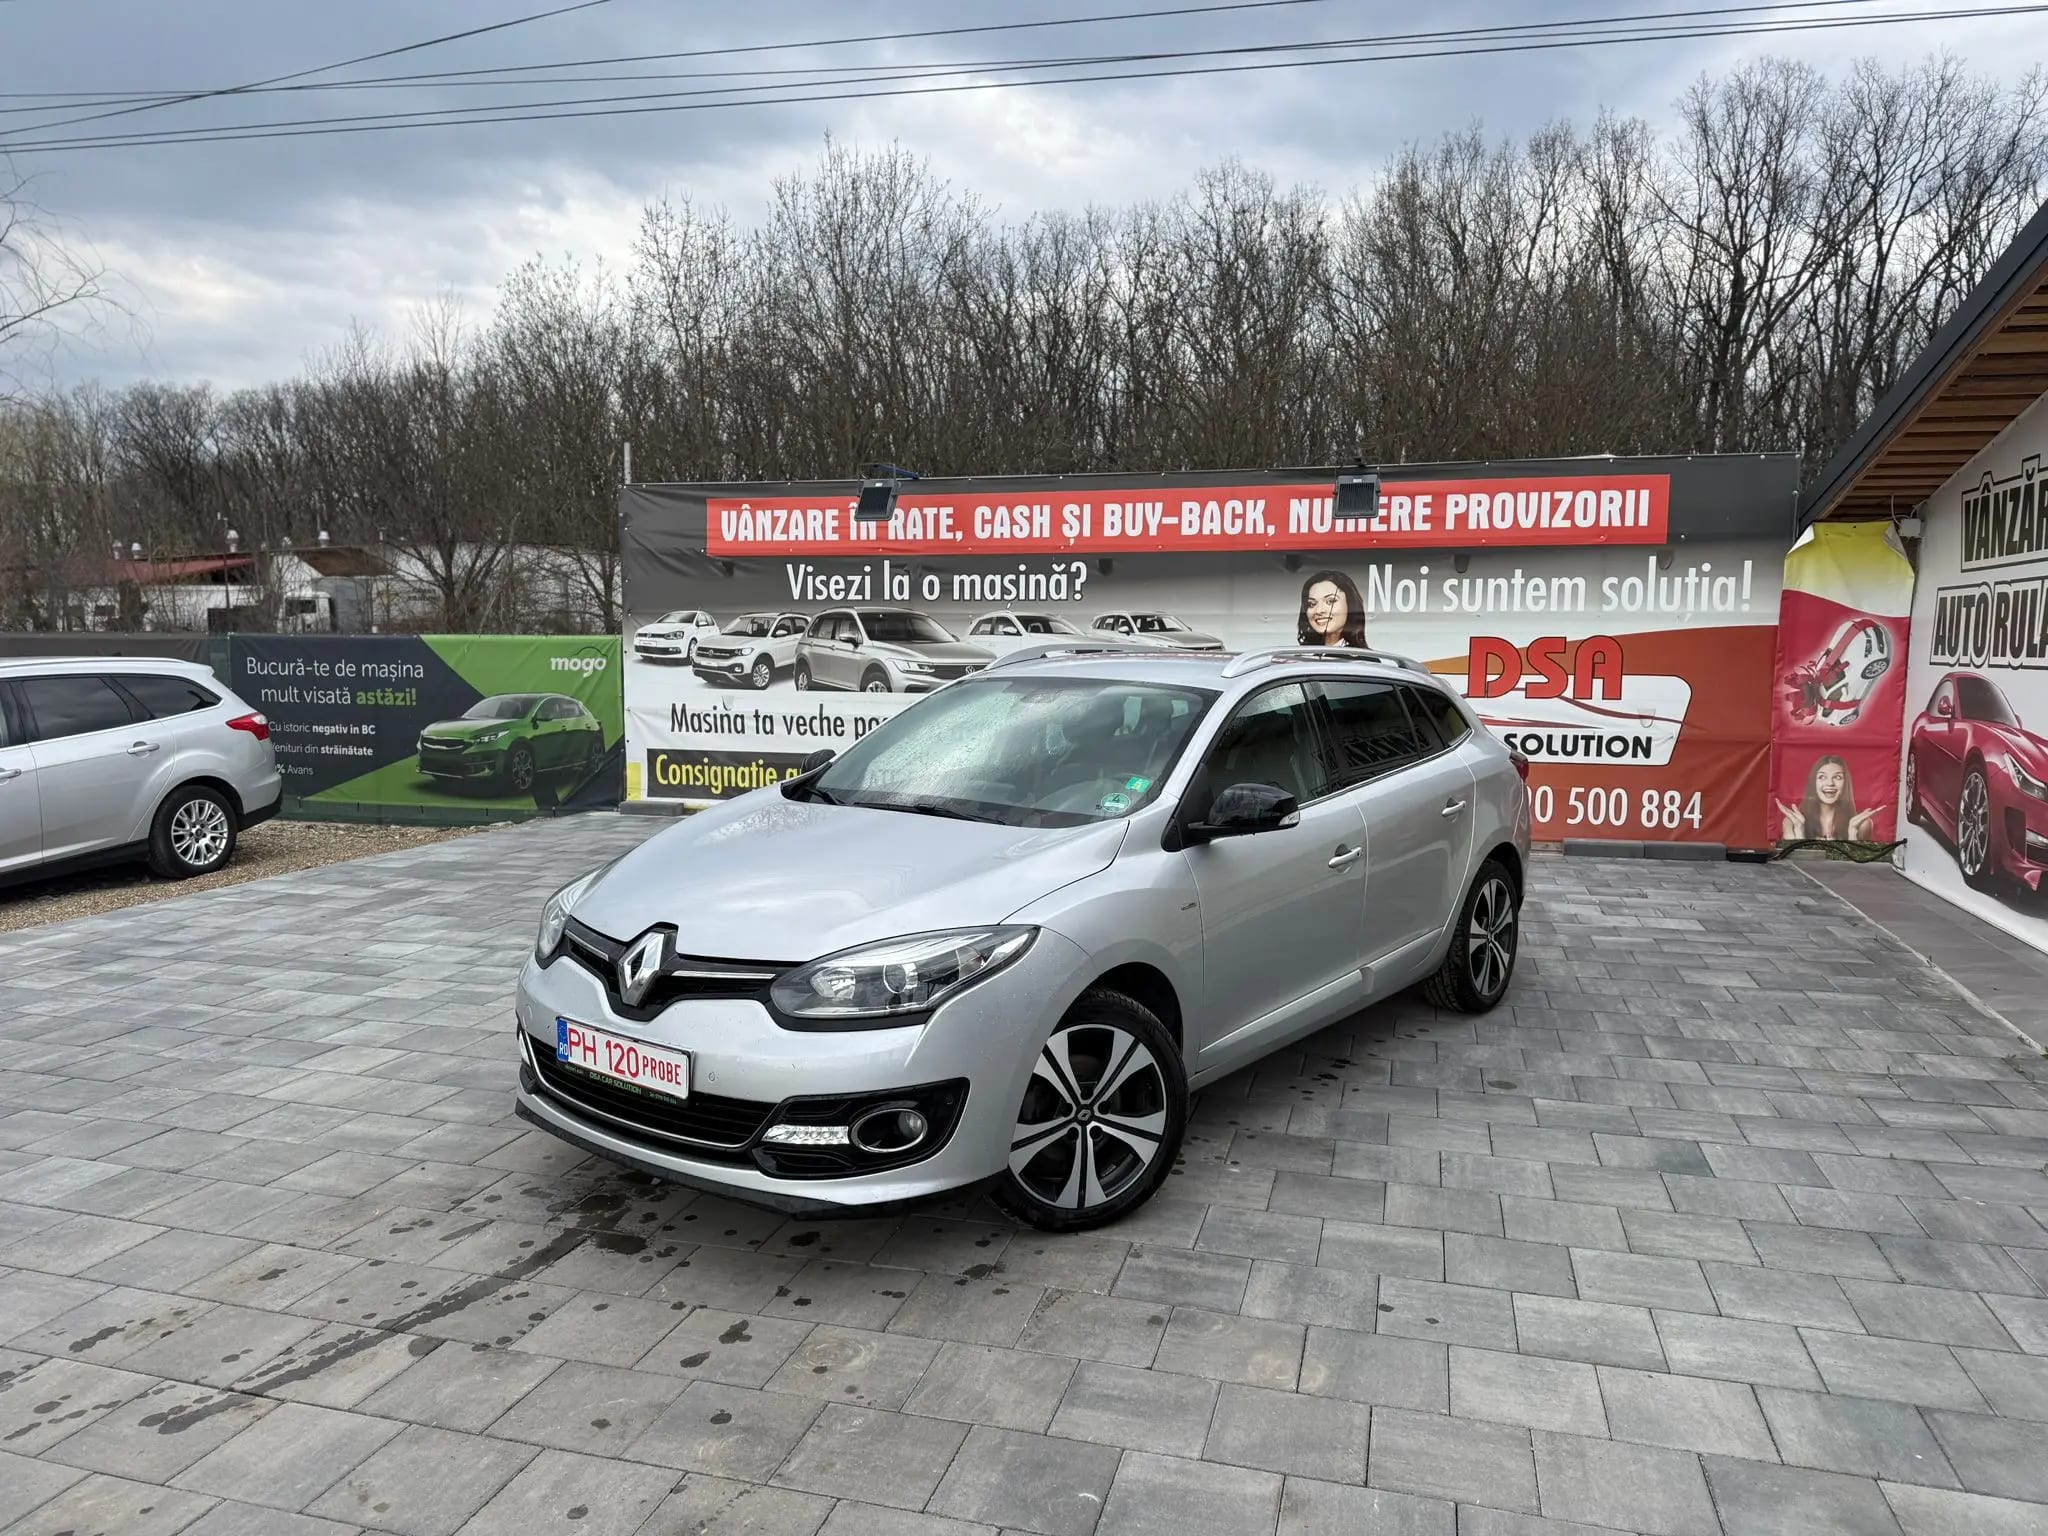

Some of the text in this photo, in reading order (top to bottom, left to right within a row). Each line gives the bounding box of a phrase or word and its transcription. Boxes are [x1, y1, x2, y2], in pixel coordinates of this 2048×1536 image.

[721, 504, 839, 541] VÂNZARE
[888, 507, 963, 541] RATE,
[974, 505, 1050, 538] CASH
[1103, 499, 1276, 537] BUY-BACK,
[1445, 489, 1650, 530] PROVIZORII
[787, 564, 871, 600] Visezi
[883, 560, 910, 600] la
[922, 575, 941, 600] o
[1368, 563, 1429, 613] Noi
[1443, 569, 1586, 612] suntem
[1933, 592, 1990, 659] AUTO
[246, 657, 424, 681] Bucură-te de mașina
[550, 657, 607, 678] mogo
[1467, 635, 1623, 700] DSA
[261, 686, 417, 706] mult visată astăzi!
[268, 721, 282, 732] Cu
[283, 722, 310, 733] istoric
[312, 723, 348, 735] negativ
[362, 725, 376, 735] BC
[754, 709, 774, 735] ta
[783, 704, 846, 737] veche
[304, 744, 319, 754] din
[1504, 733, 1653, 759] SOLUTION
[287, 764, 314, 775] Avans
[1566, 786, 1628, 826] 500
[1640, 789, 1702, 829] 884
[568, 1027, 682, 1086] PH 120 PROBE
